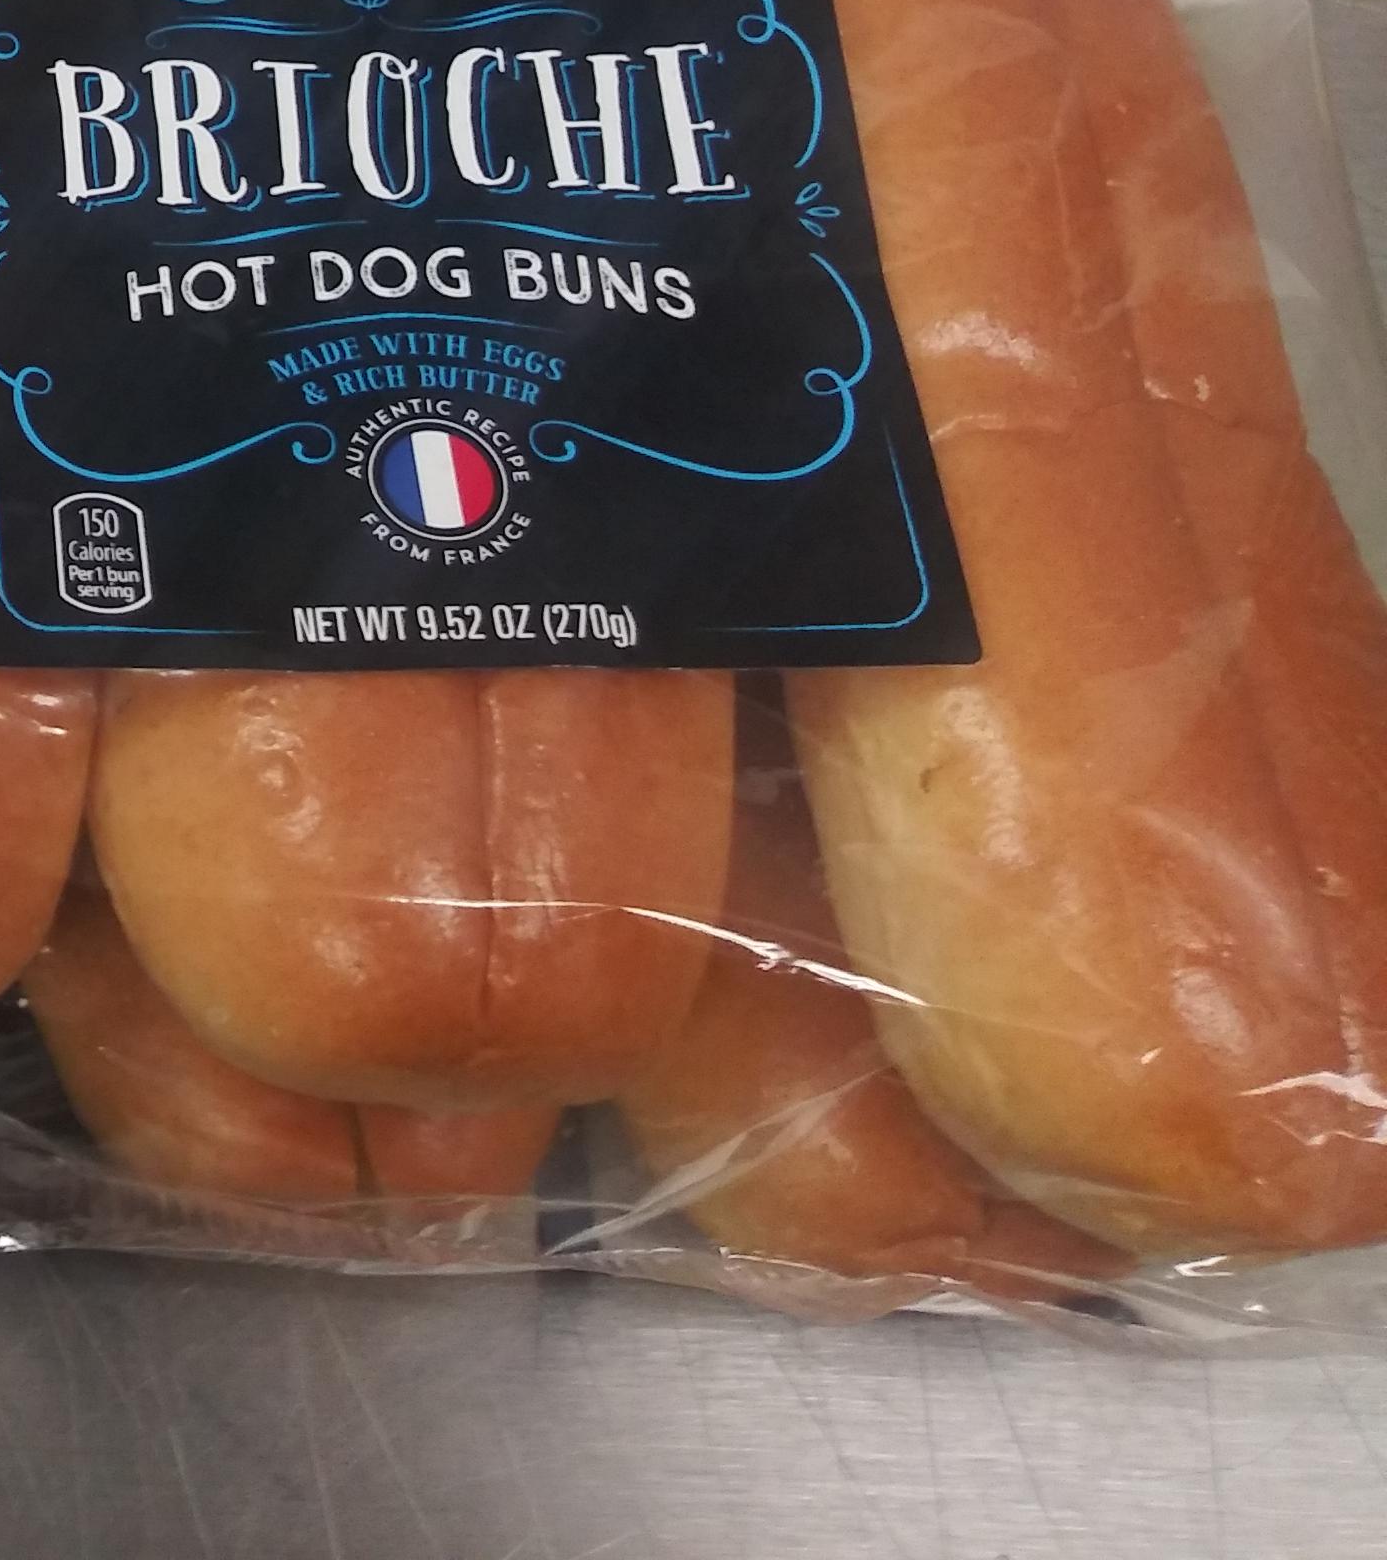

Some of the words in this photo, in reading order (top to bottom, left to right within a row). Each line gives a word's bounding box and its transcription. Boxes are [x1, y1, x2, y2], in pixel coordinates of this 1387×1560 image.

[46, 42, 741, 208] BRIOCHE
[126, 254, 276, 322] HOT
[308, 246, 472, 303] DOG
[503, 247, 697, 320] BUNS
[266, 336, 362, 382] MADE
[369, 331, 469, 359] WITH
[482, 339, 567, 382] EGGS
[300, 380, 327, 405] &
[332, 364, 408, 397] RICH
[416, 364, 541, 406] BUTTER
[344, 397, 455, 480] AUTHENTIC
[462, 407, 532, 484] RECIPE
[78, 507, 120, 538] 150
[359, 511, 431, 563] FROM
[443, 510, 533, 566] FRANCE
[68, 540, 135, 562] Calories
[77, 582, 136, 603] serving
[106, 565, 141, 583] bun
[292, 605, 349, 642] NET
[354, 605, 409, 641] WT
[416, 604, 488, 640] 9.52
[492, 604, 537, 639] OZ
[542, 603, 638, 648] (270g)
